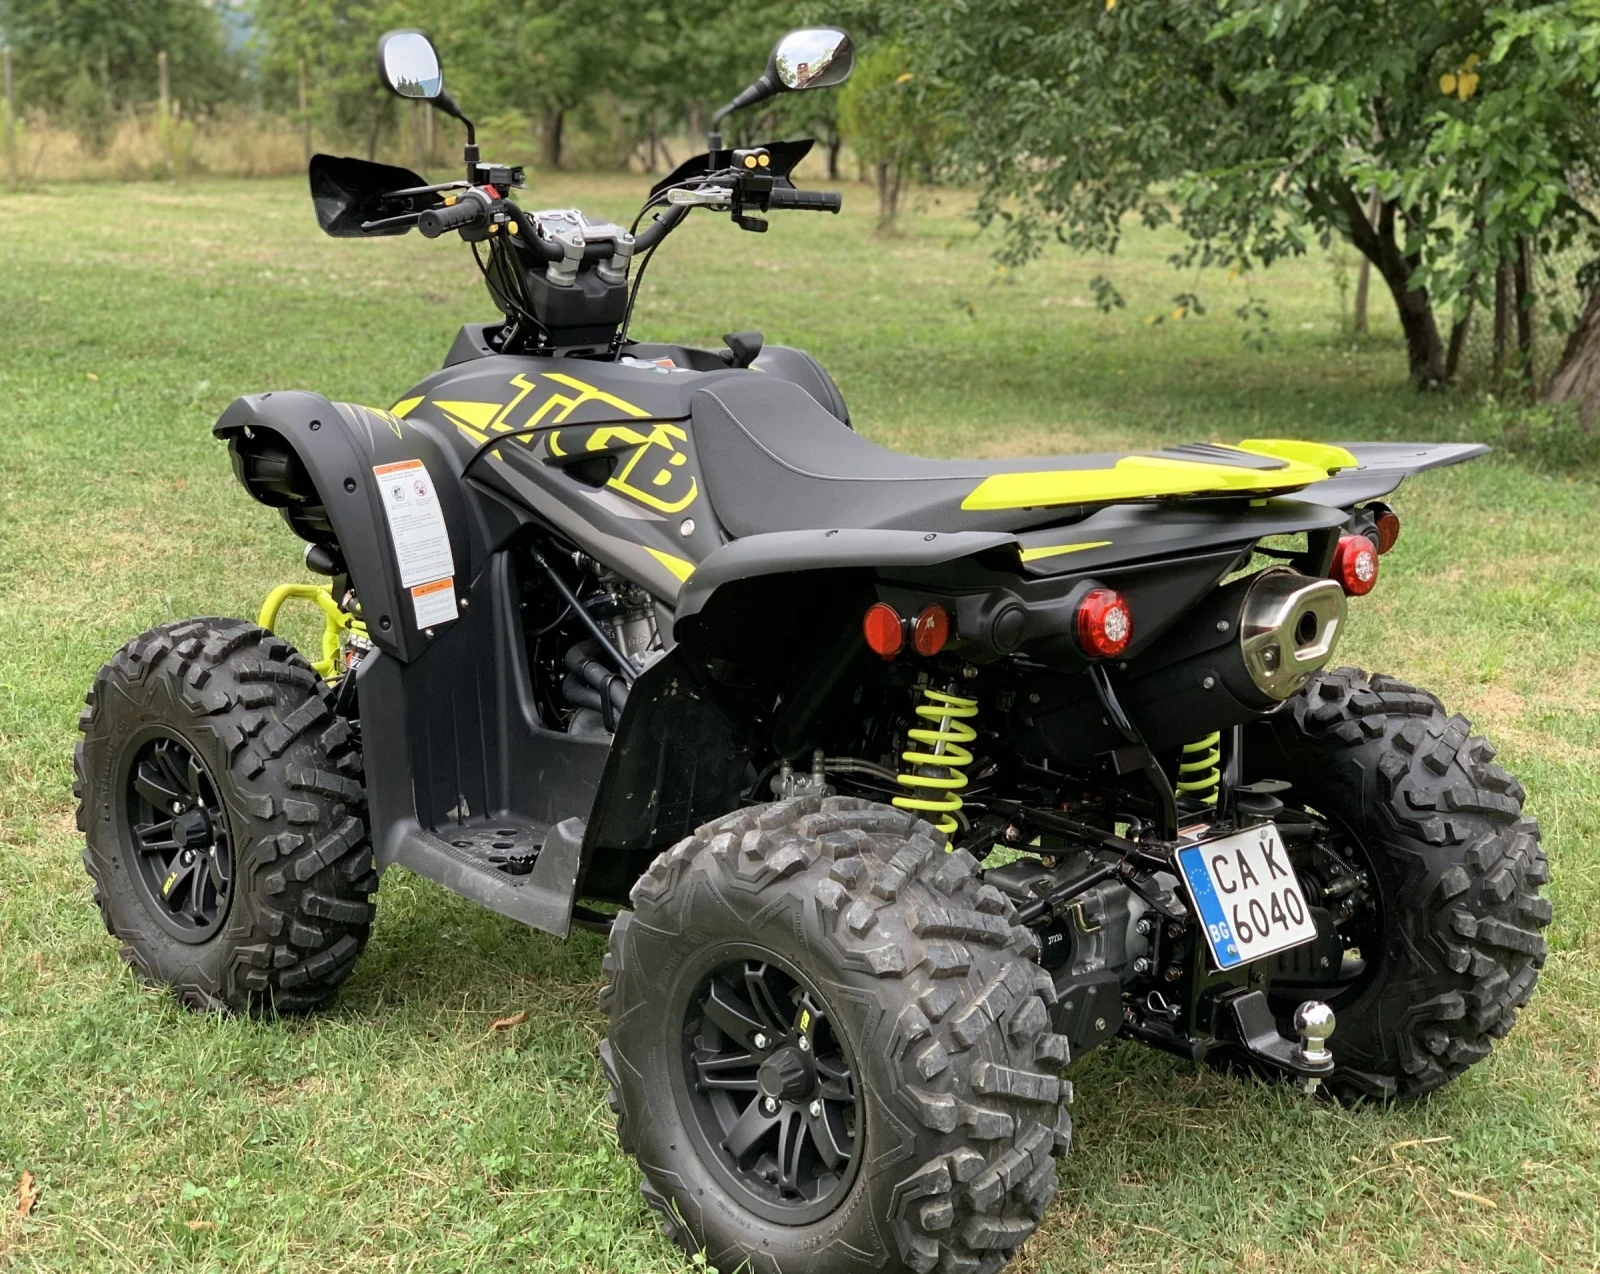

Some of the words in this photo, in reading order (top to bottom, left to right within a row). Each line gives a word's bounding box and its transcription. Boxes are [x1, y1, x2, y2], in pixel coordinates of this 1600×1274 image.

[1212, 849, 1259, 894] CA
[1259, 838, 1288, 880] K
[1207, 921, 1230, 943] BG
[1233, 887, 1304, 944] 6040
